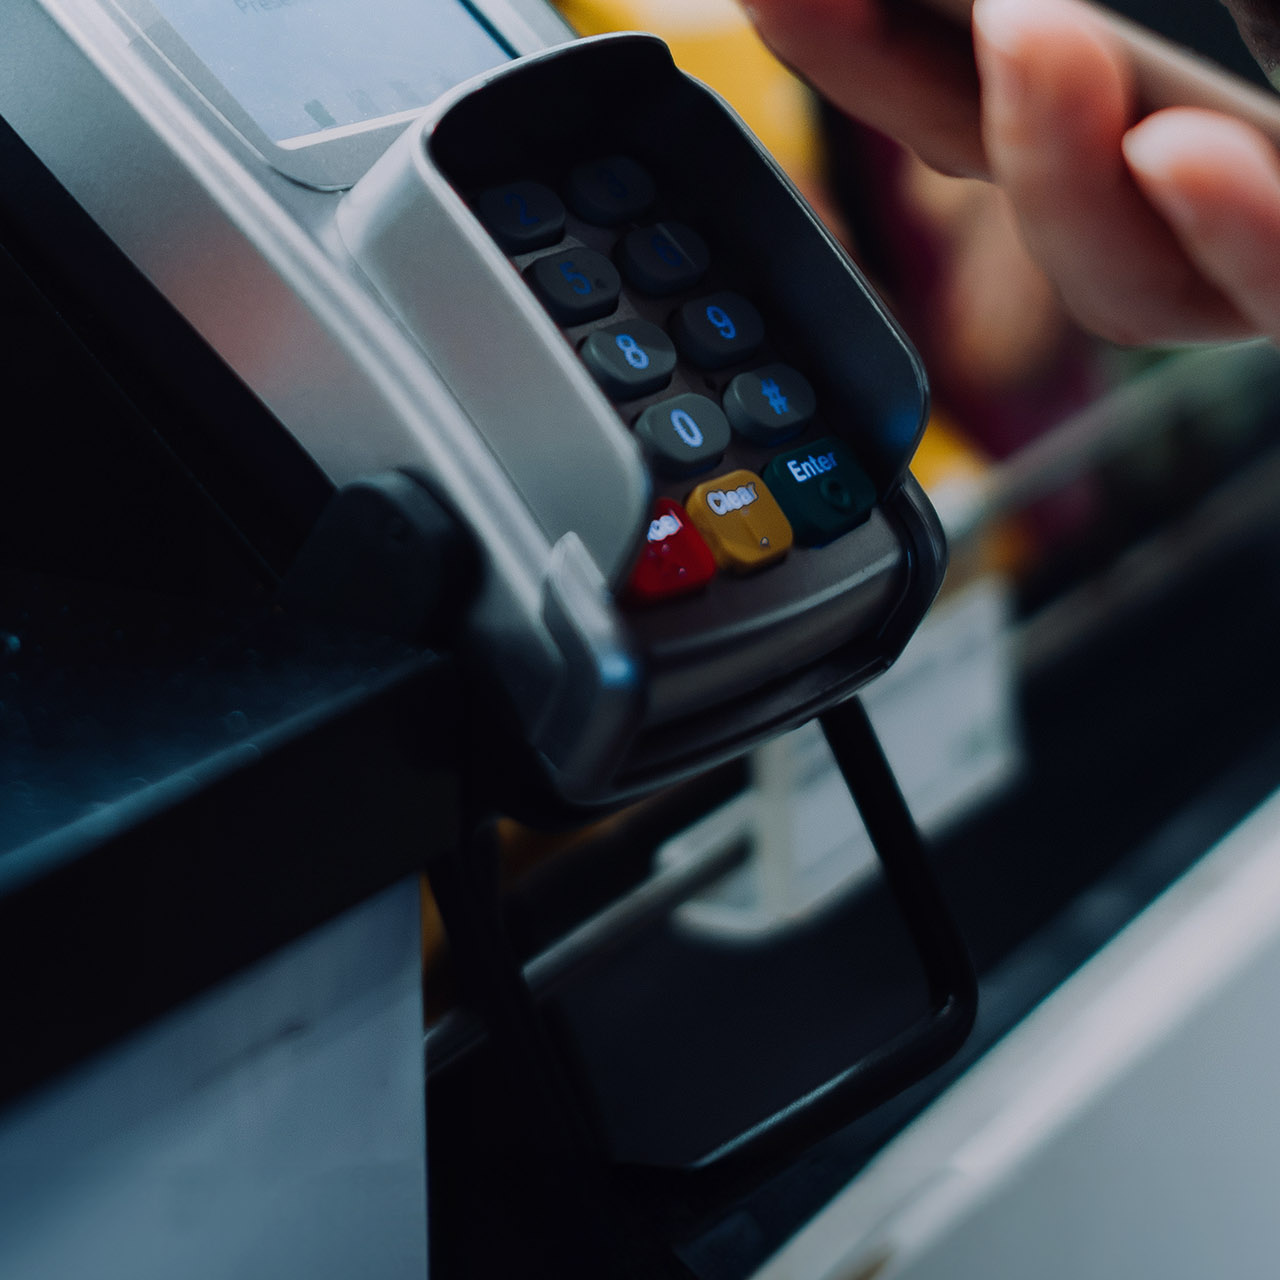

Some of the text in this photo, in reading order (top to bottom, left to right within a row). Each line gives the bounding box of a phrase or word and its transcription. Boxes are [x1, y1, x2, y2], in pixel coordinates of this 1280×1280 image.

[503, 191, 541, 227] 2
[650, 232, 684, 267] 6
[559, 260, 593, 296] 5
[705, 305, 737, 340] 9
[615, 333, 650, 370] 8
[760, 377, 791, 415] #
[669, 408, 704, 448] 0
[786, 450, 838, 483] Enter
[706, 481, 759, 516] Clear
